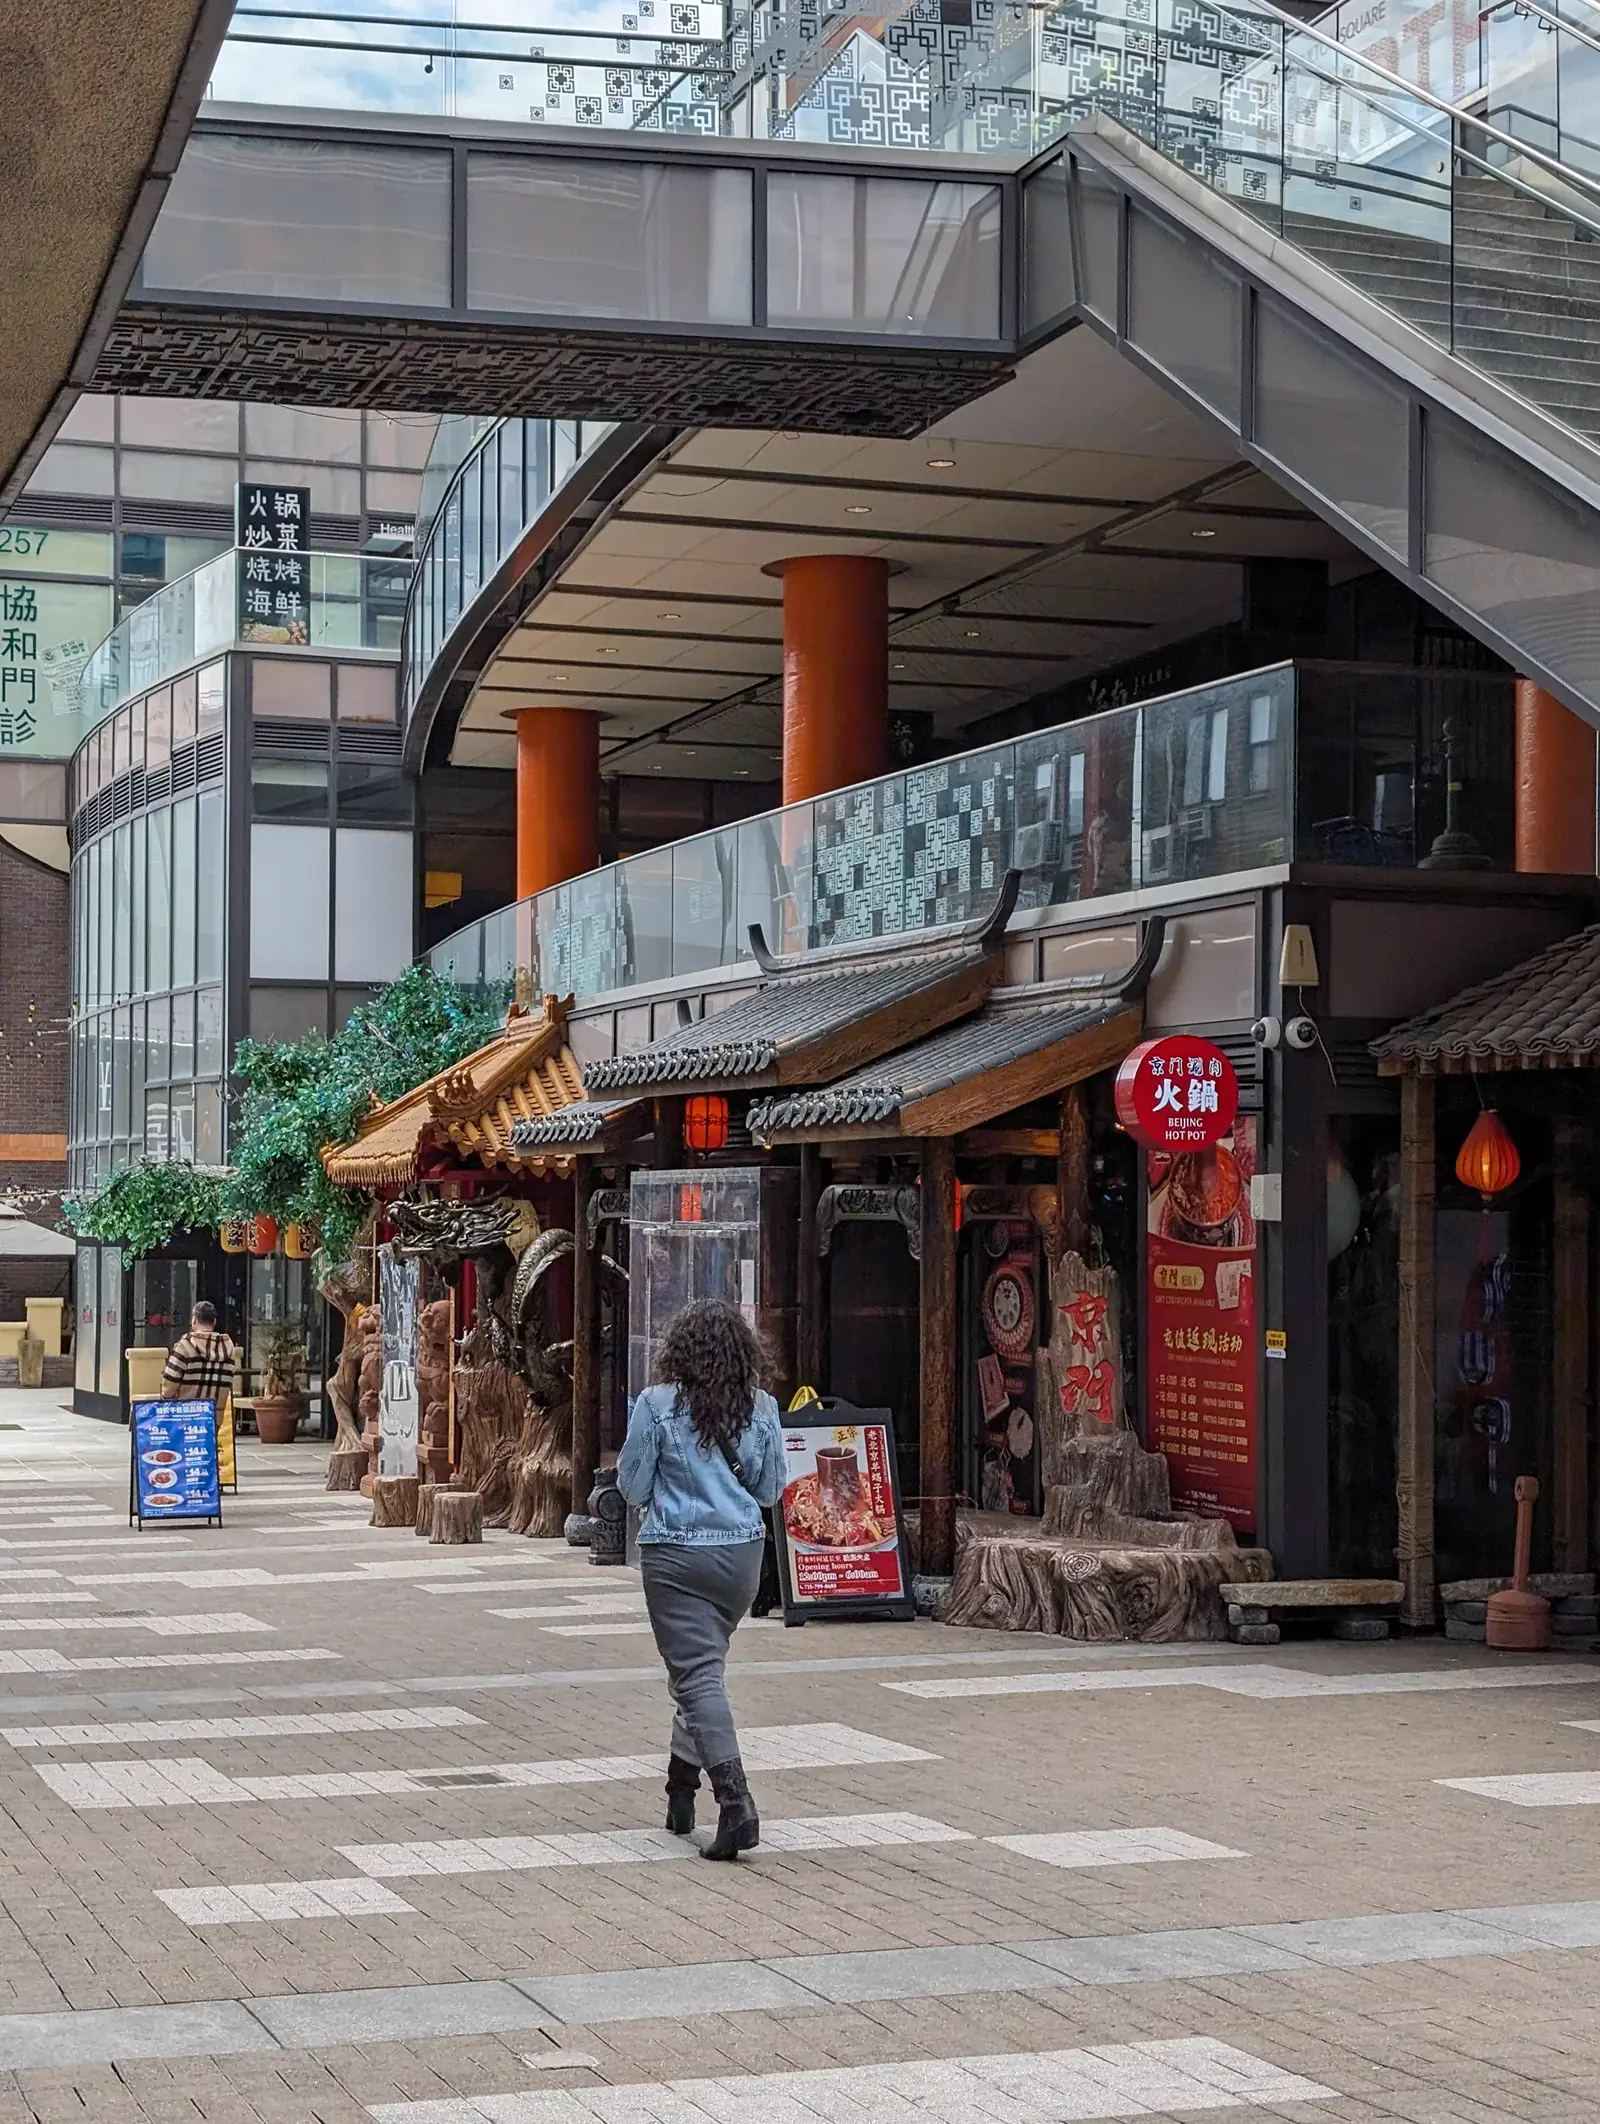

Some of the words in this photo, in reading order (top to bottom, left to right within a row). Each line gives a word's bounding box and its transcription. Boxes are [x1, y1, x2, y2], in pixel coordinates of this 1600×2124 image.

[1339, 0, 1387, 45] SQUARE
[250, 490, 300, 519] 火锅
[245, 523, 300, 550] 炒菜
[246, 557, 302, 585] 烧烤
[246, 588, 302, 618] 海鲜
[0, 584, 37, 745] 協和門診
[1152, 1078, 1219, 1113] 火鍋
[1165, 1131, 1186, 1140] HOT
[1187, 1131, 1206, 1140] POT
[1168, 1118, 1204, 1129] BEIJING
[837, 1425, 858, 1443] 正宗
[798, 1563, 830, 1572] Opening
[831, 1562, 853, 1570] hours
